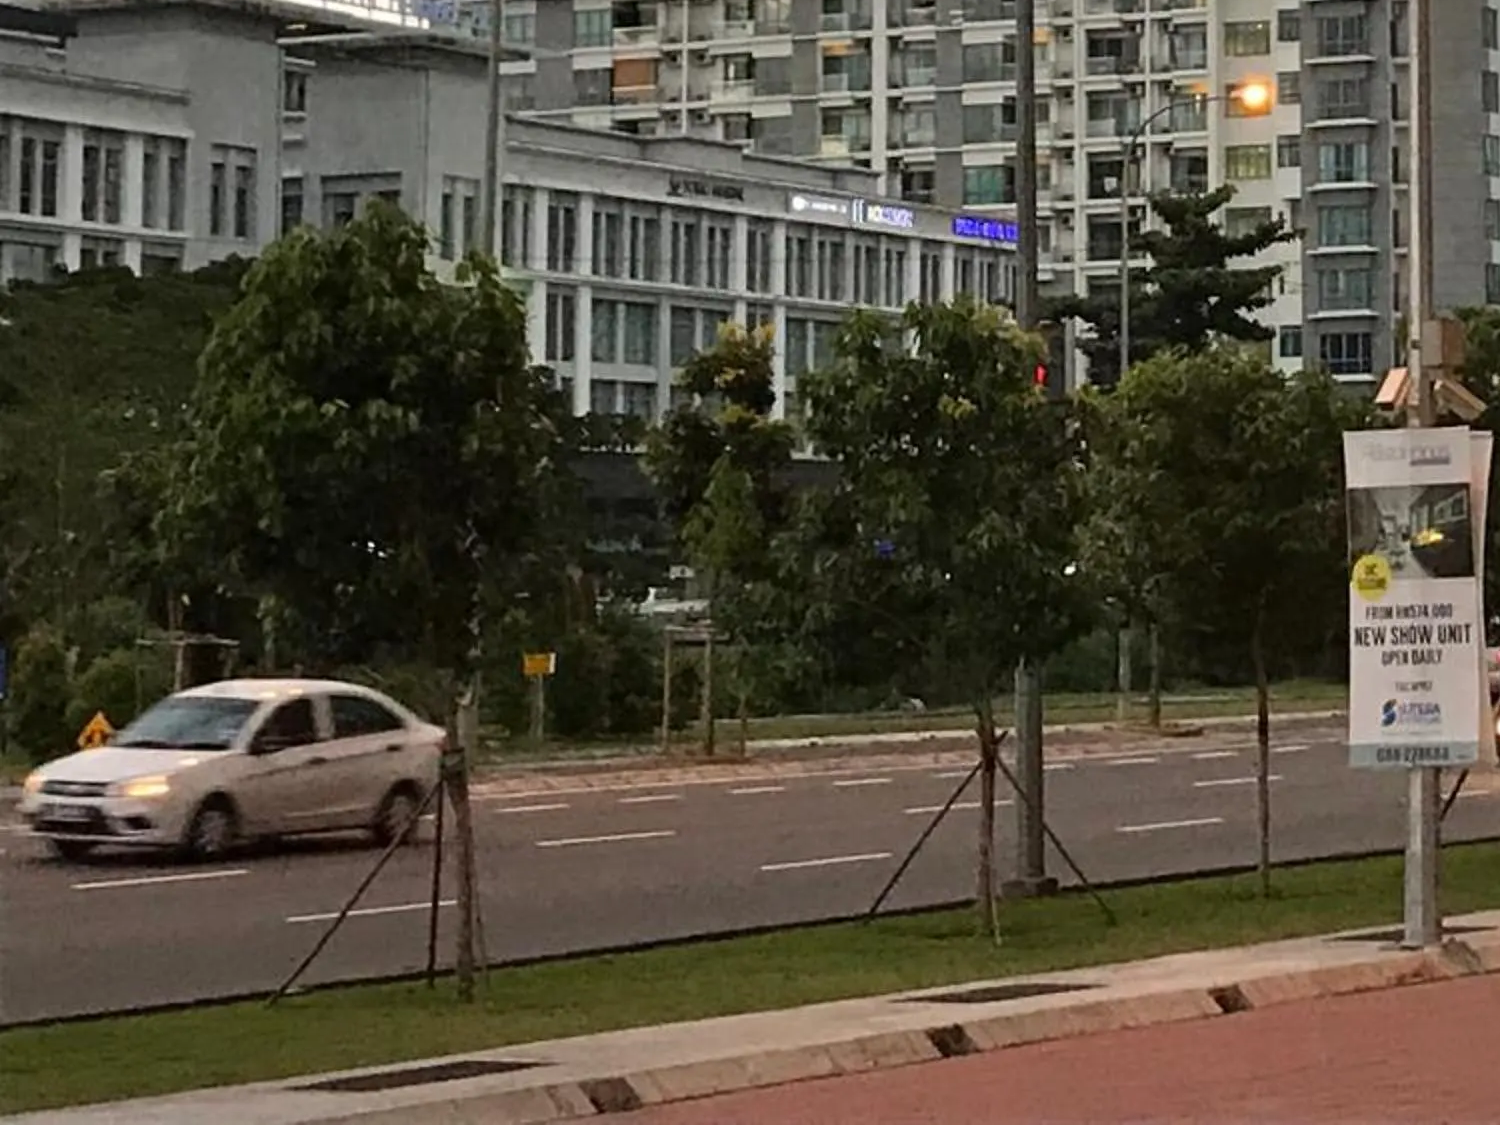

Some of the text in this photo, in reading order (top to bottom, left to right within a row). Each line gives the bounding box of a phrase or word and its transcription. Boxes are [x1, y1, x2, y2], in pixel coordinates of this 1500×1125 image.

[1354, 623, 1472, 647] NEW SHOW UNIT
[1382, 648, 1443, 667] OPEN DAILY
